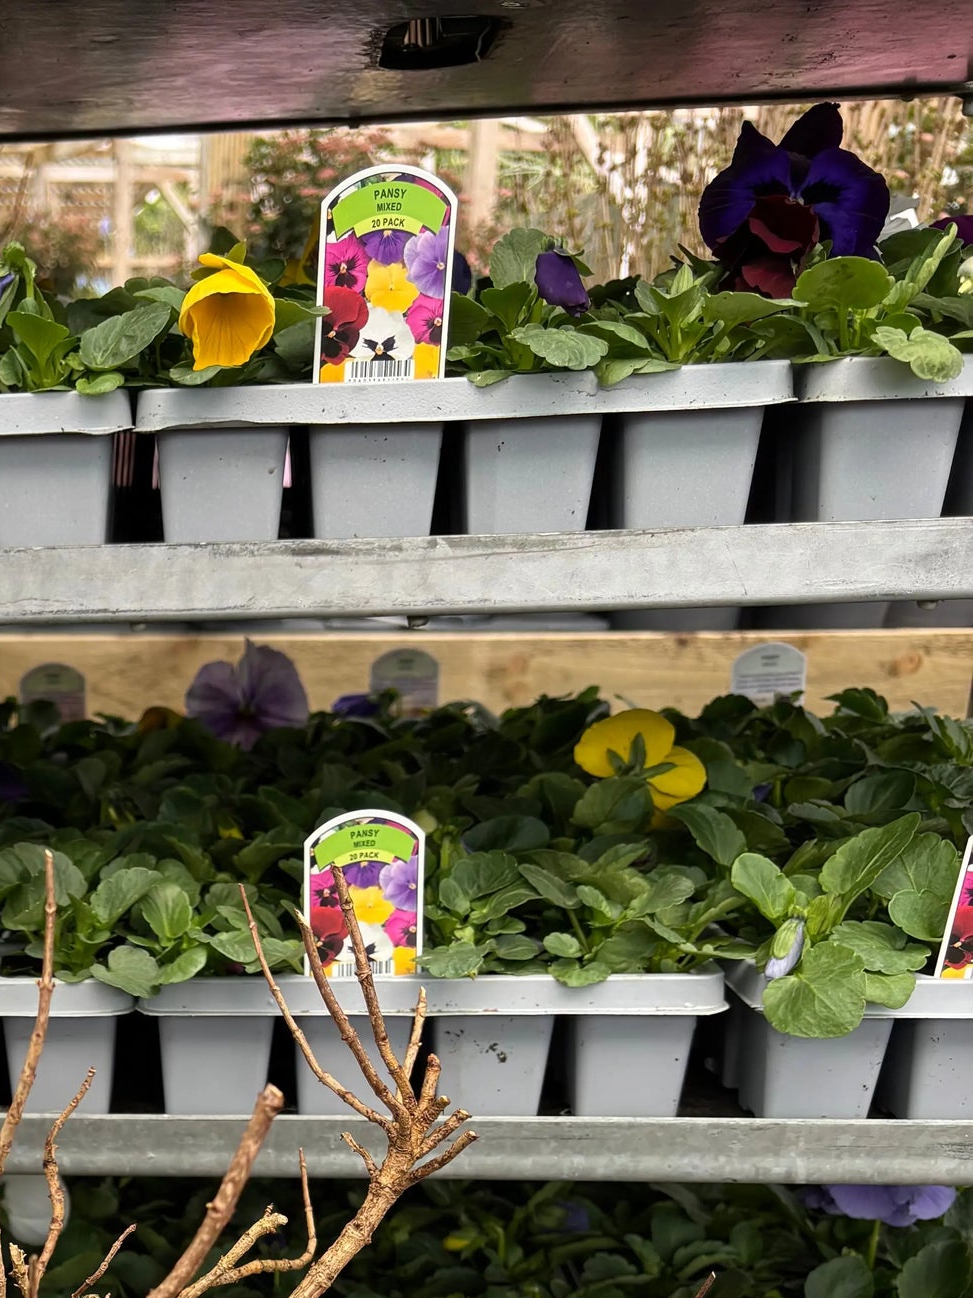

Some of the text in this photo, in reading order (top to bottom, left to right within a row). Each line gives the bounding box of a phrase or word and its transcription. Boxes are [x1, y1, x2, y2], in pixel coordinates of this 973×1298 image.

[373, 188, 407, 200] PANSY
[376, 202, 402, 212] MIXED
[371, 217, 406, 229] 20 PACK
[350, 829, 380, 839] PANSY
[353, 840, 376, 848] MIXED
[349, 851, 380, 861] 20 PACK
